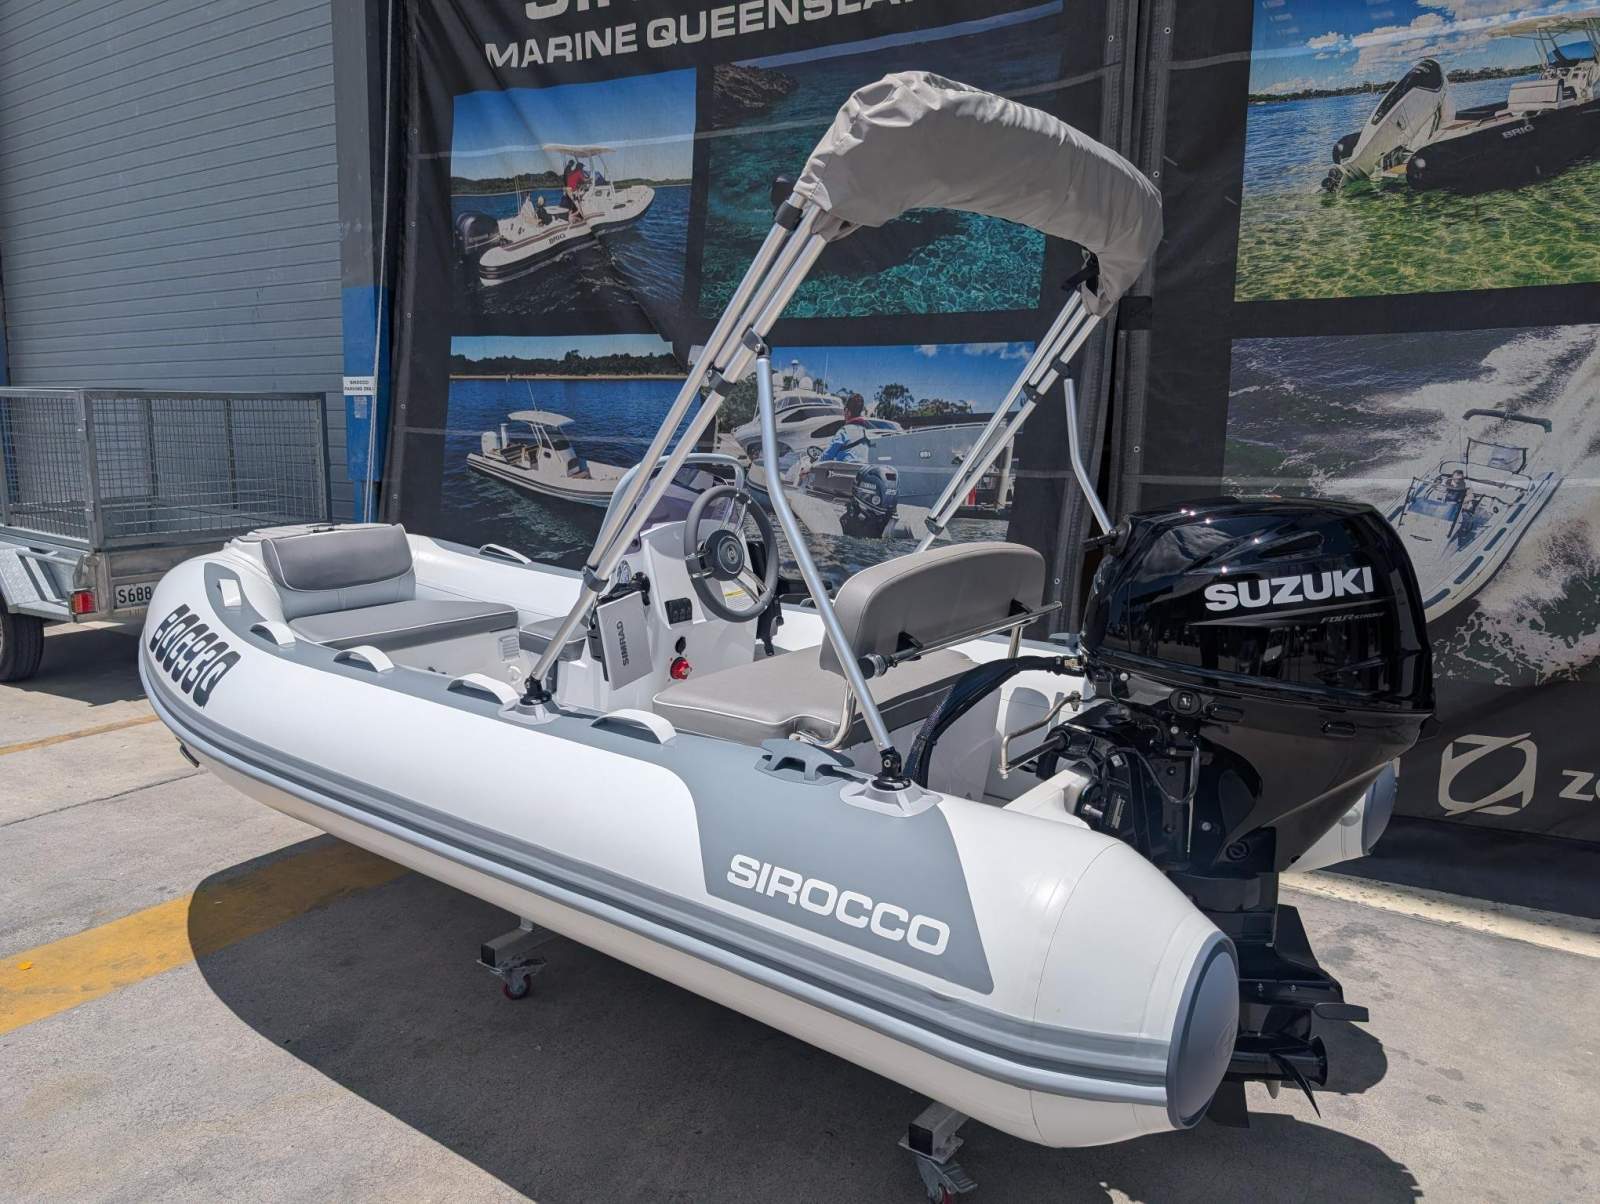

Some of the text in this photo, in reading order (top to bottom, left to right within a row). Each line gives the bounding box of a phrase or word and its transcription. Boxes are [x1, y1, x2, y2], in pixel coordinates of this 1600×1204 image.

[485, 22, 638, 69] MARINE
[646, 0, 914, 48] QUEENSL
[118, 586, 152, 604] S688
[1204, 566, 1374, 612] SUZUKI
[616, 620, 630, 667] SIMRAD
[726, 854, 951, 956] SIROCCO
